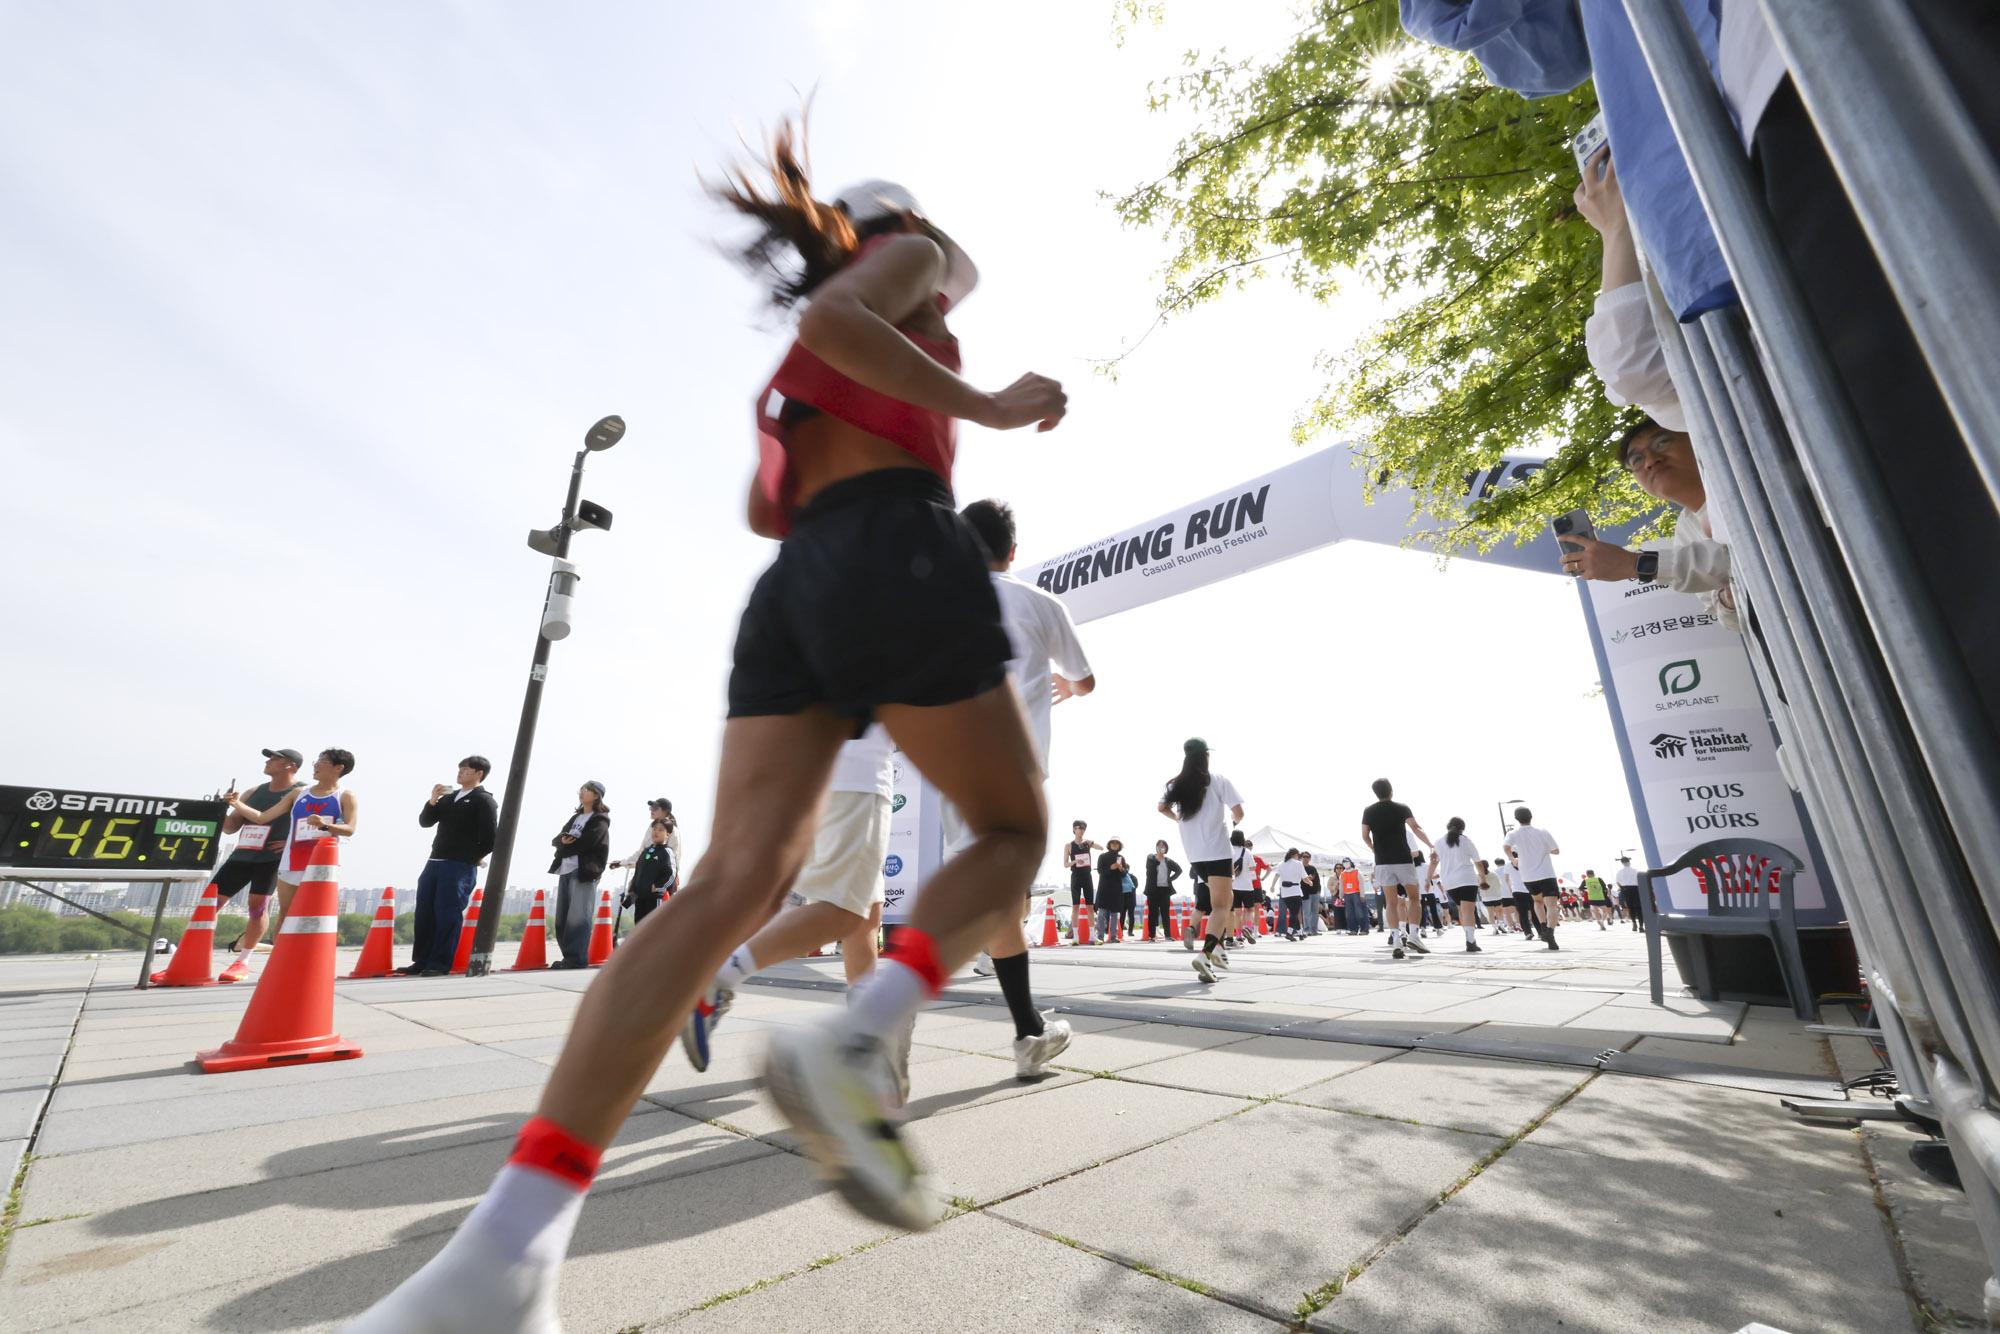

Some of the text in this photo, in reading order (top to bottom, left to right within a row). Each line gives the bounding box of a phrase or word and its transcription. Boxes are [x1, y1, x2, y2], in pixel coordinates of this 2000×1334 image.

[1036, 484, 1271, 595] BURNING RUN
[1142, 525, 1268, 578] Casual Running Festival
[1655, 695, 1720, 711] SLIMPLANET
[1690, 733, 1749, 748] Habitat
[1709, 744, 1751, 753] Humanity
[1680, 783, 1745, 801] TOUS
[60, 794, 180, 817] SAMIK
[1706, 800, 1728, 814] les
[164, 820, 208, 835] 10km
[1686, 812, 1760, 834] JOURS
